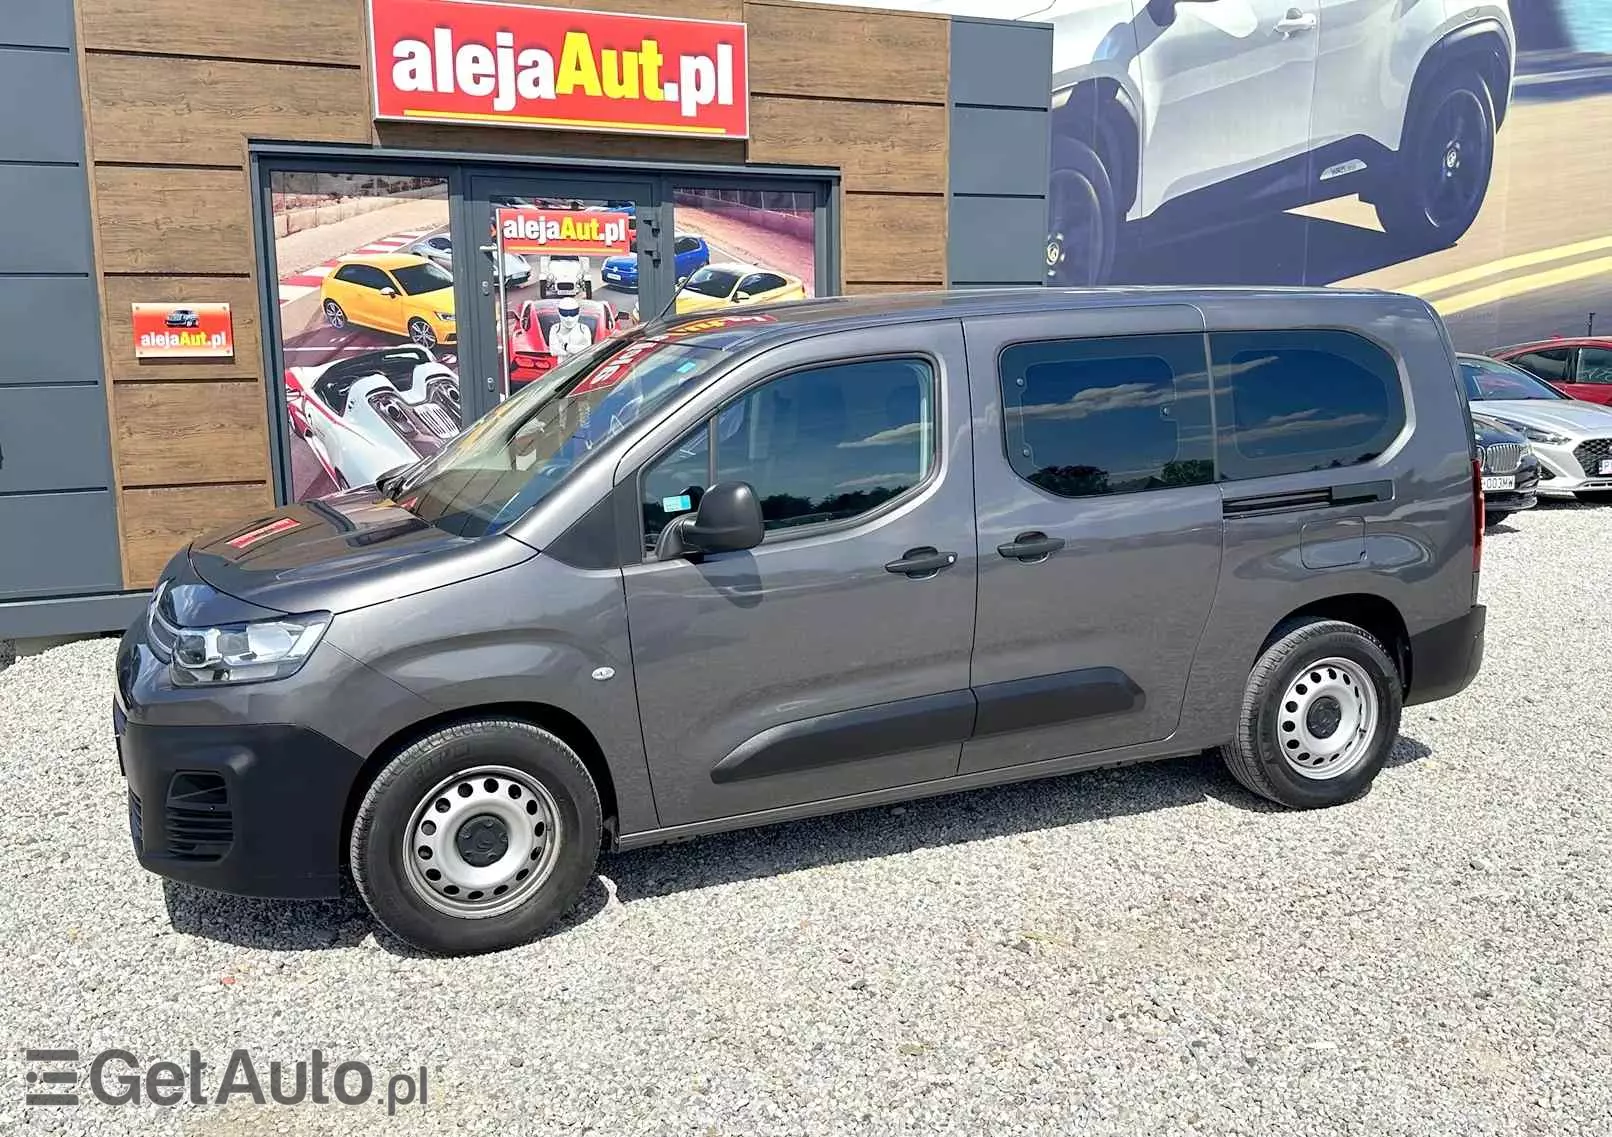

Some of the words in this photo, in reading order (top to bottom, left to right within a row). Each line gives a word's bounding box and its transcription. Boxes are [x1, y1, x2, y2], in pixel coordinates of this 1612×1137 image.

[392, 27, 734, 117] alejaAut.pl
[503, 215, 626, 246] alejaAut.pl
[141, 332, 226, 349] alejaAut.pl
